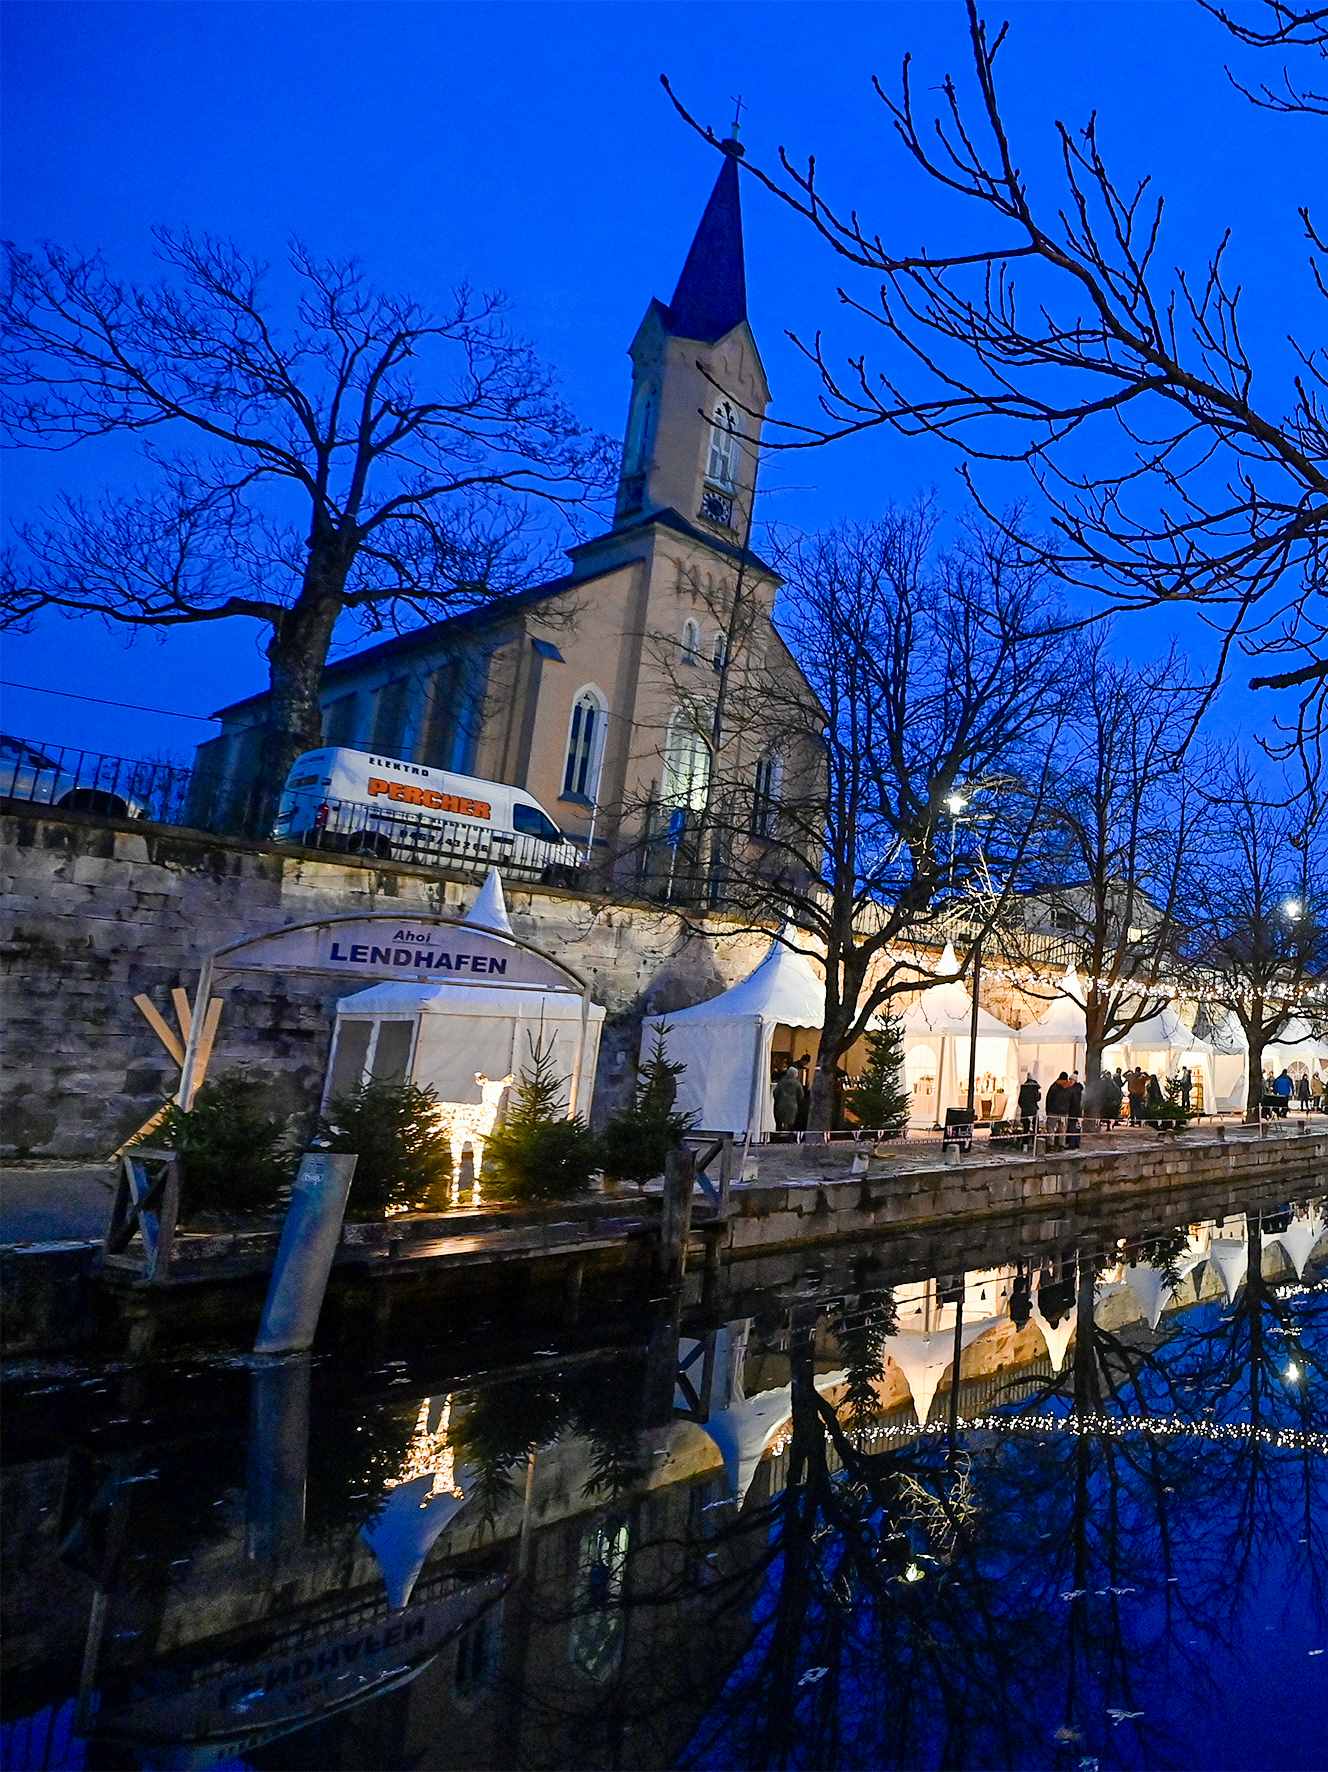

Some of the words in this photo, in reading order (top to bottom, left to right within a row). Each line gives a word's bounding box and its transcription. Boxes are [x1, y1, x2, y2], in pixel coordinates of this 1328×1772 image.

[368, 757, 429, 777] ELEKTRO
[367, 777, 491, 820] PERCHER
[393, 930, 431, 943] Ahoi
[329, 942, 507, 975] LENDHAFEN
